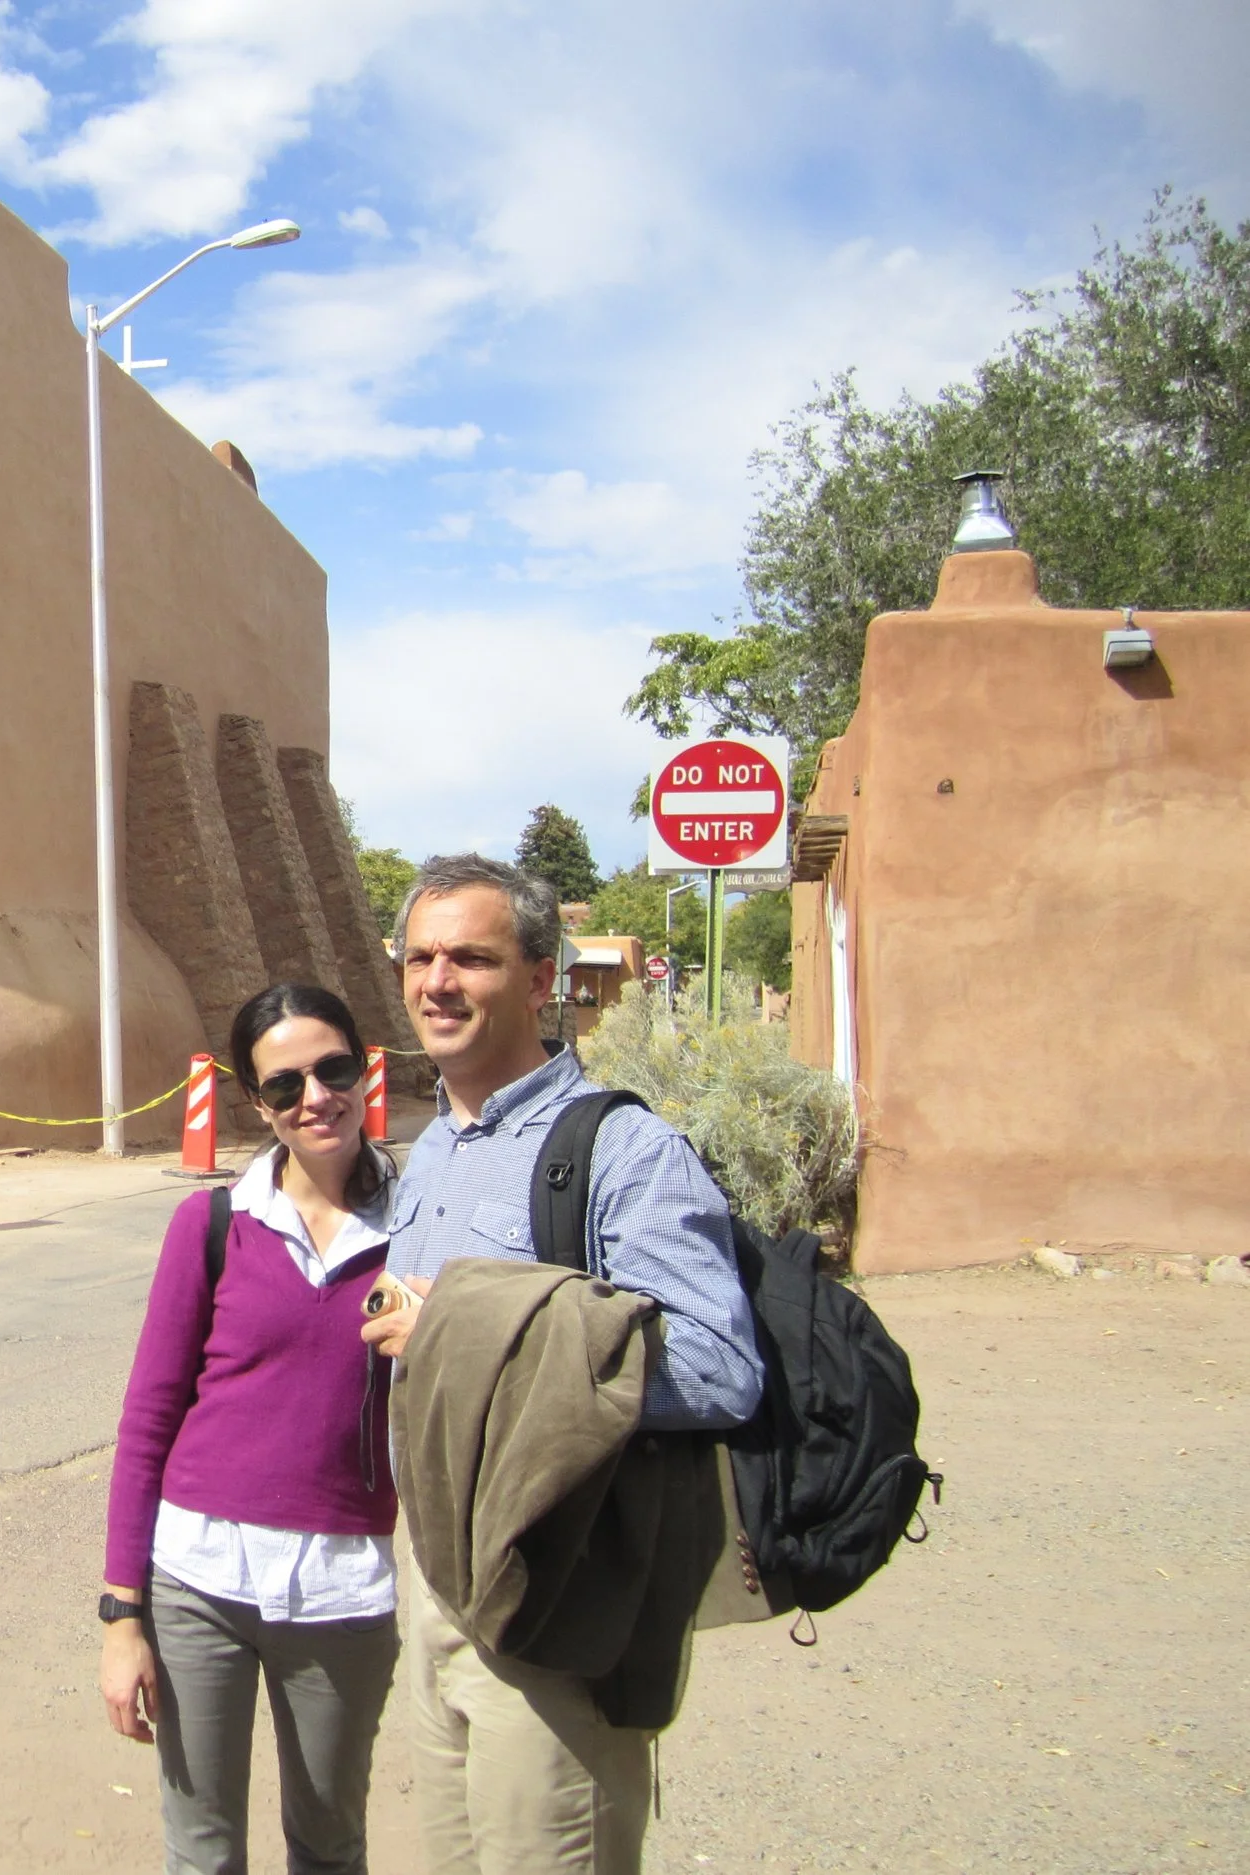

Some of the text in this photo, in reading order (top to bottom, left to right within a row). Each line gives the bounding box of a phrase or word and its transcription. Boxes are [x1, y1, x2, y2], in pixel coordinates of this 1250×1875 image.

[672, 764, 765, 785] DO NOT
[679, 821, 754, 841] ENTER
